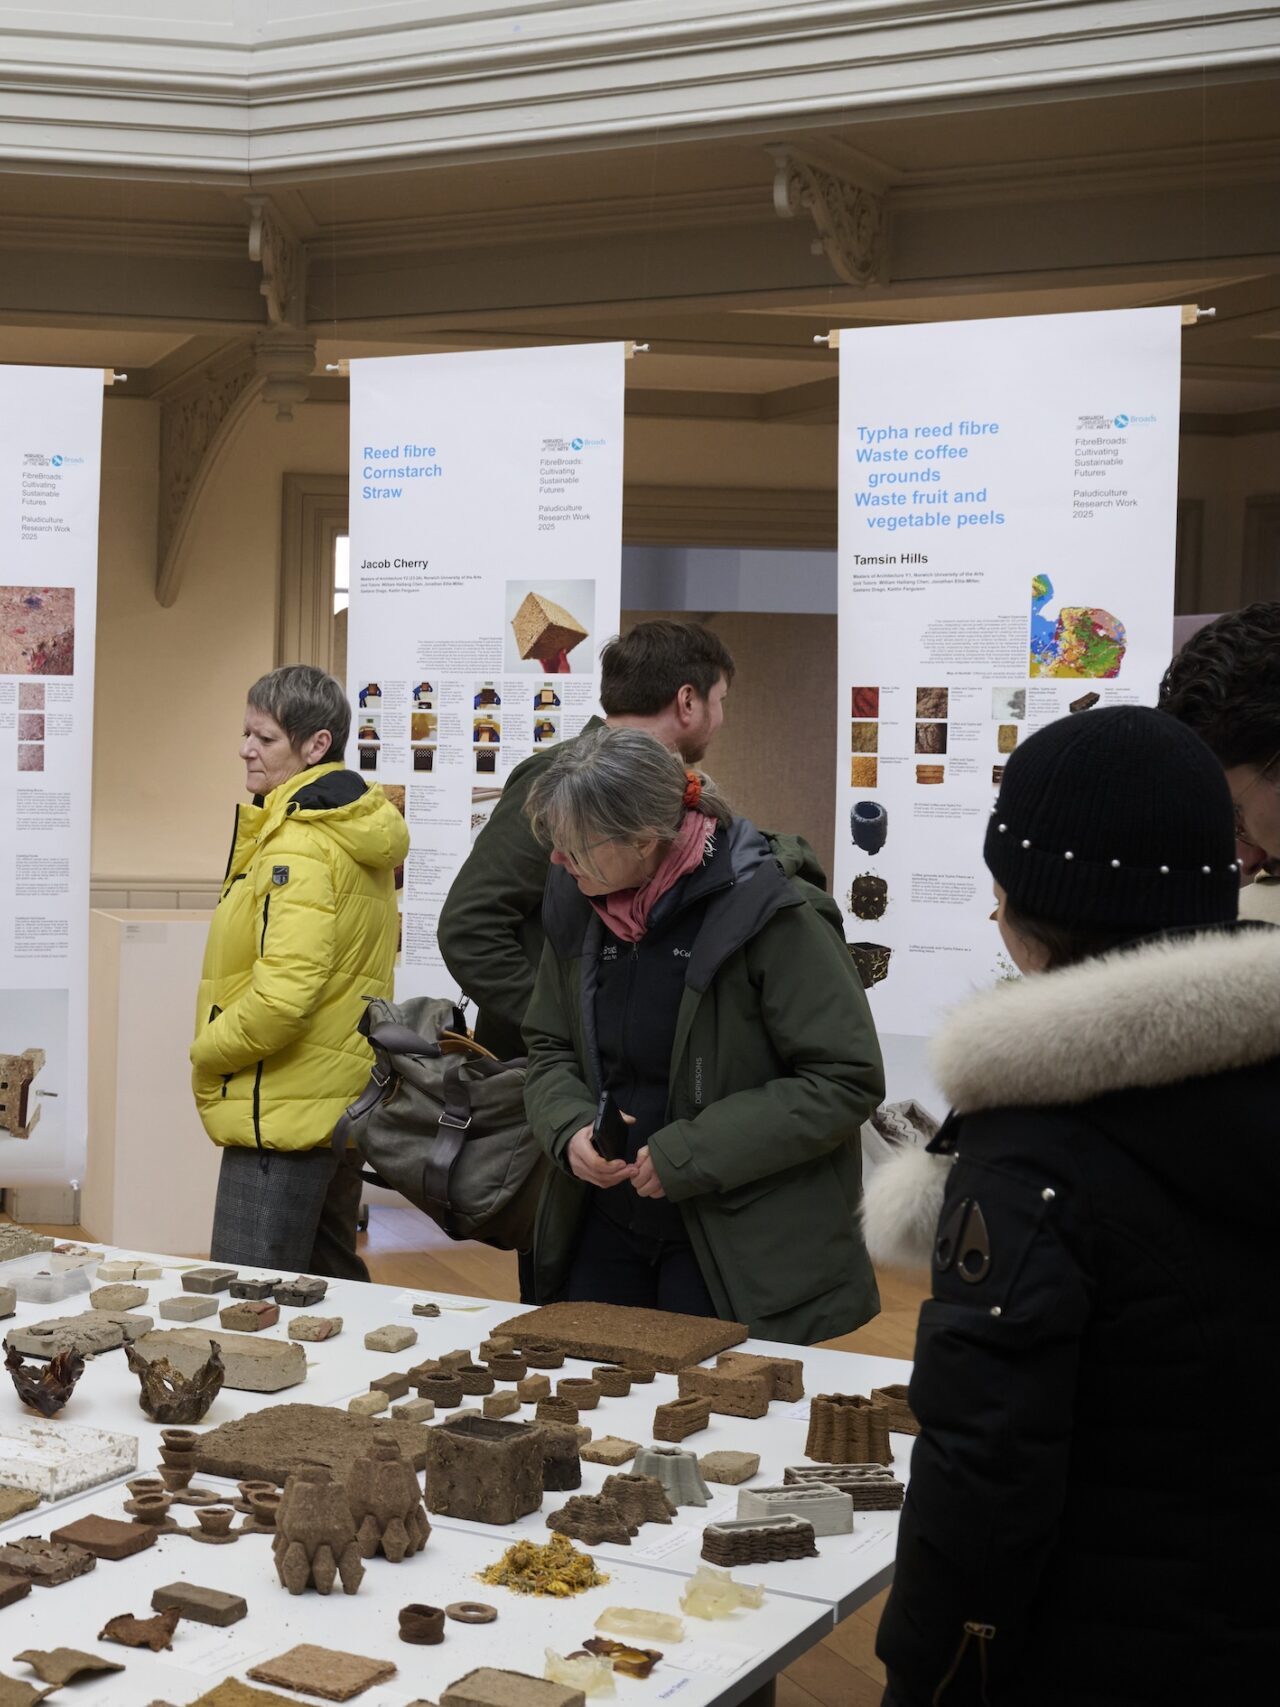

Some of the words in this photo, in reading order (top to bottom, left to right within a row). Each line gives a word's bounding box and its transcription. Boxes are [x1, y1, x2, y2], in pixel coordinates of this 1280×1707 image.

[1130, 414, 1157, 423] Broads
[857, 425, 909, 444] Typha
[914, 422, 953, 439] reed
[959, 420, 1000, 436] fibre
[363, 446, 400, 460] Reed
[404, 444, 437, 458] fibre
[856, 448, 908, 463] Waste
[914, 445, 969, 461] coffee
[1074, 447, 1119, 457] Cultivating
[1074, 457, 1124, 467] Sustainable
[363, 464, 443, 480] Cornstarch
[539, 467, 575, 476] Cultivating
[1074, 469, 1106, 477] Futures
[539, 476, 580, 485] Sustainable
[868, 468, 941, 488] grounds
[22, 481, 56, 490] Cultivating
[539, 486, 565, 494] Futures
[21, 490, 60, 498] Sustainable
[362, 486, 403, 500] Straw
[855, 491, 907, 507] Waste
[912, 489, 948, 505] fruit
[954, 488, 987, 504] and
[1073, 488, 1128, 498] Paludiculture
[21, 498, 47, 506] Futures
[1073, 500, 1113, 508] Research
[1116, 499, 1138, 507] Work
[538, 504, 583, 512] Paludiculture
[538, 513, 571, 522] Research
[573, 513, 591, 521] Work
[1072, 510, 1094, 518] 2025
[21, 516, 64, 524] Paludiculture
[867, 511, 952, 531] vegetable
[957, 510, 1005, 529] peels
[21, 525, 53, 533] Research
[538, 523, 556, 531] 2025
[854, 553, 896, 566] Tamsin
[900, 552, 929, 564] Hills
[360, 559, 391, 570] Jacob
[393, 558, 429, 570] Cherry
